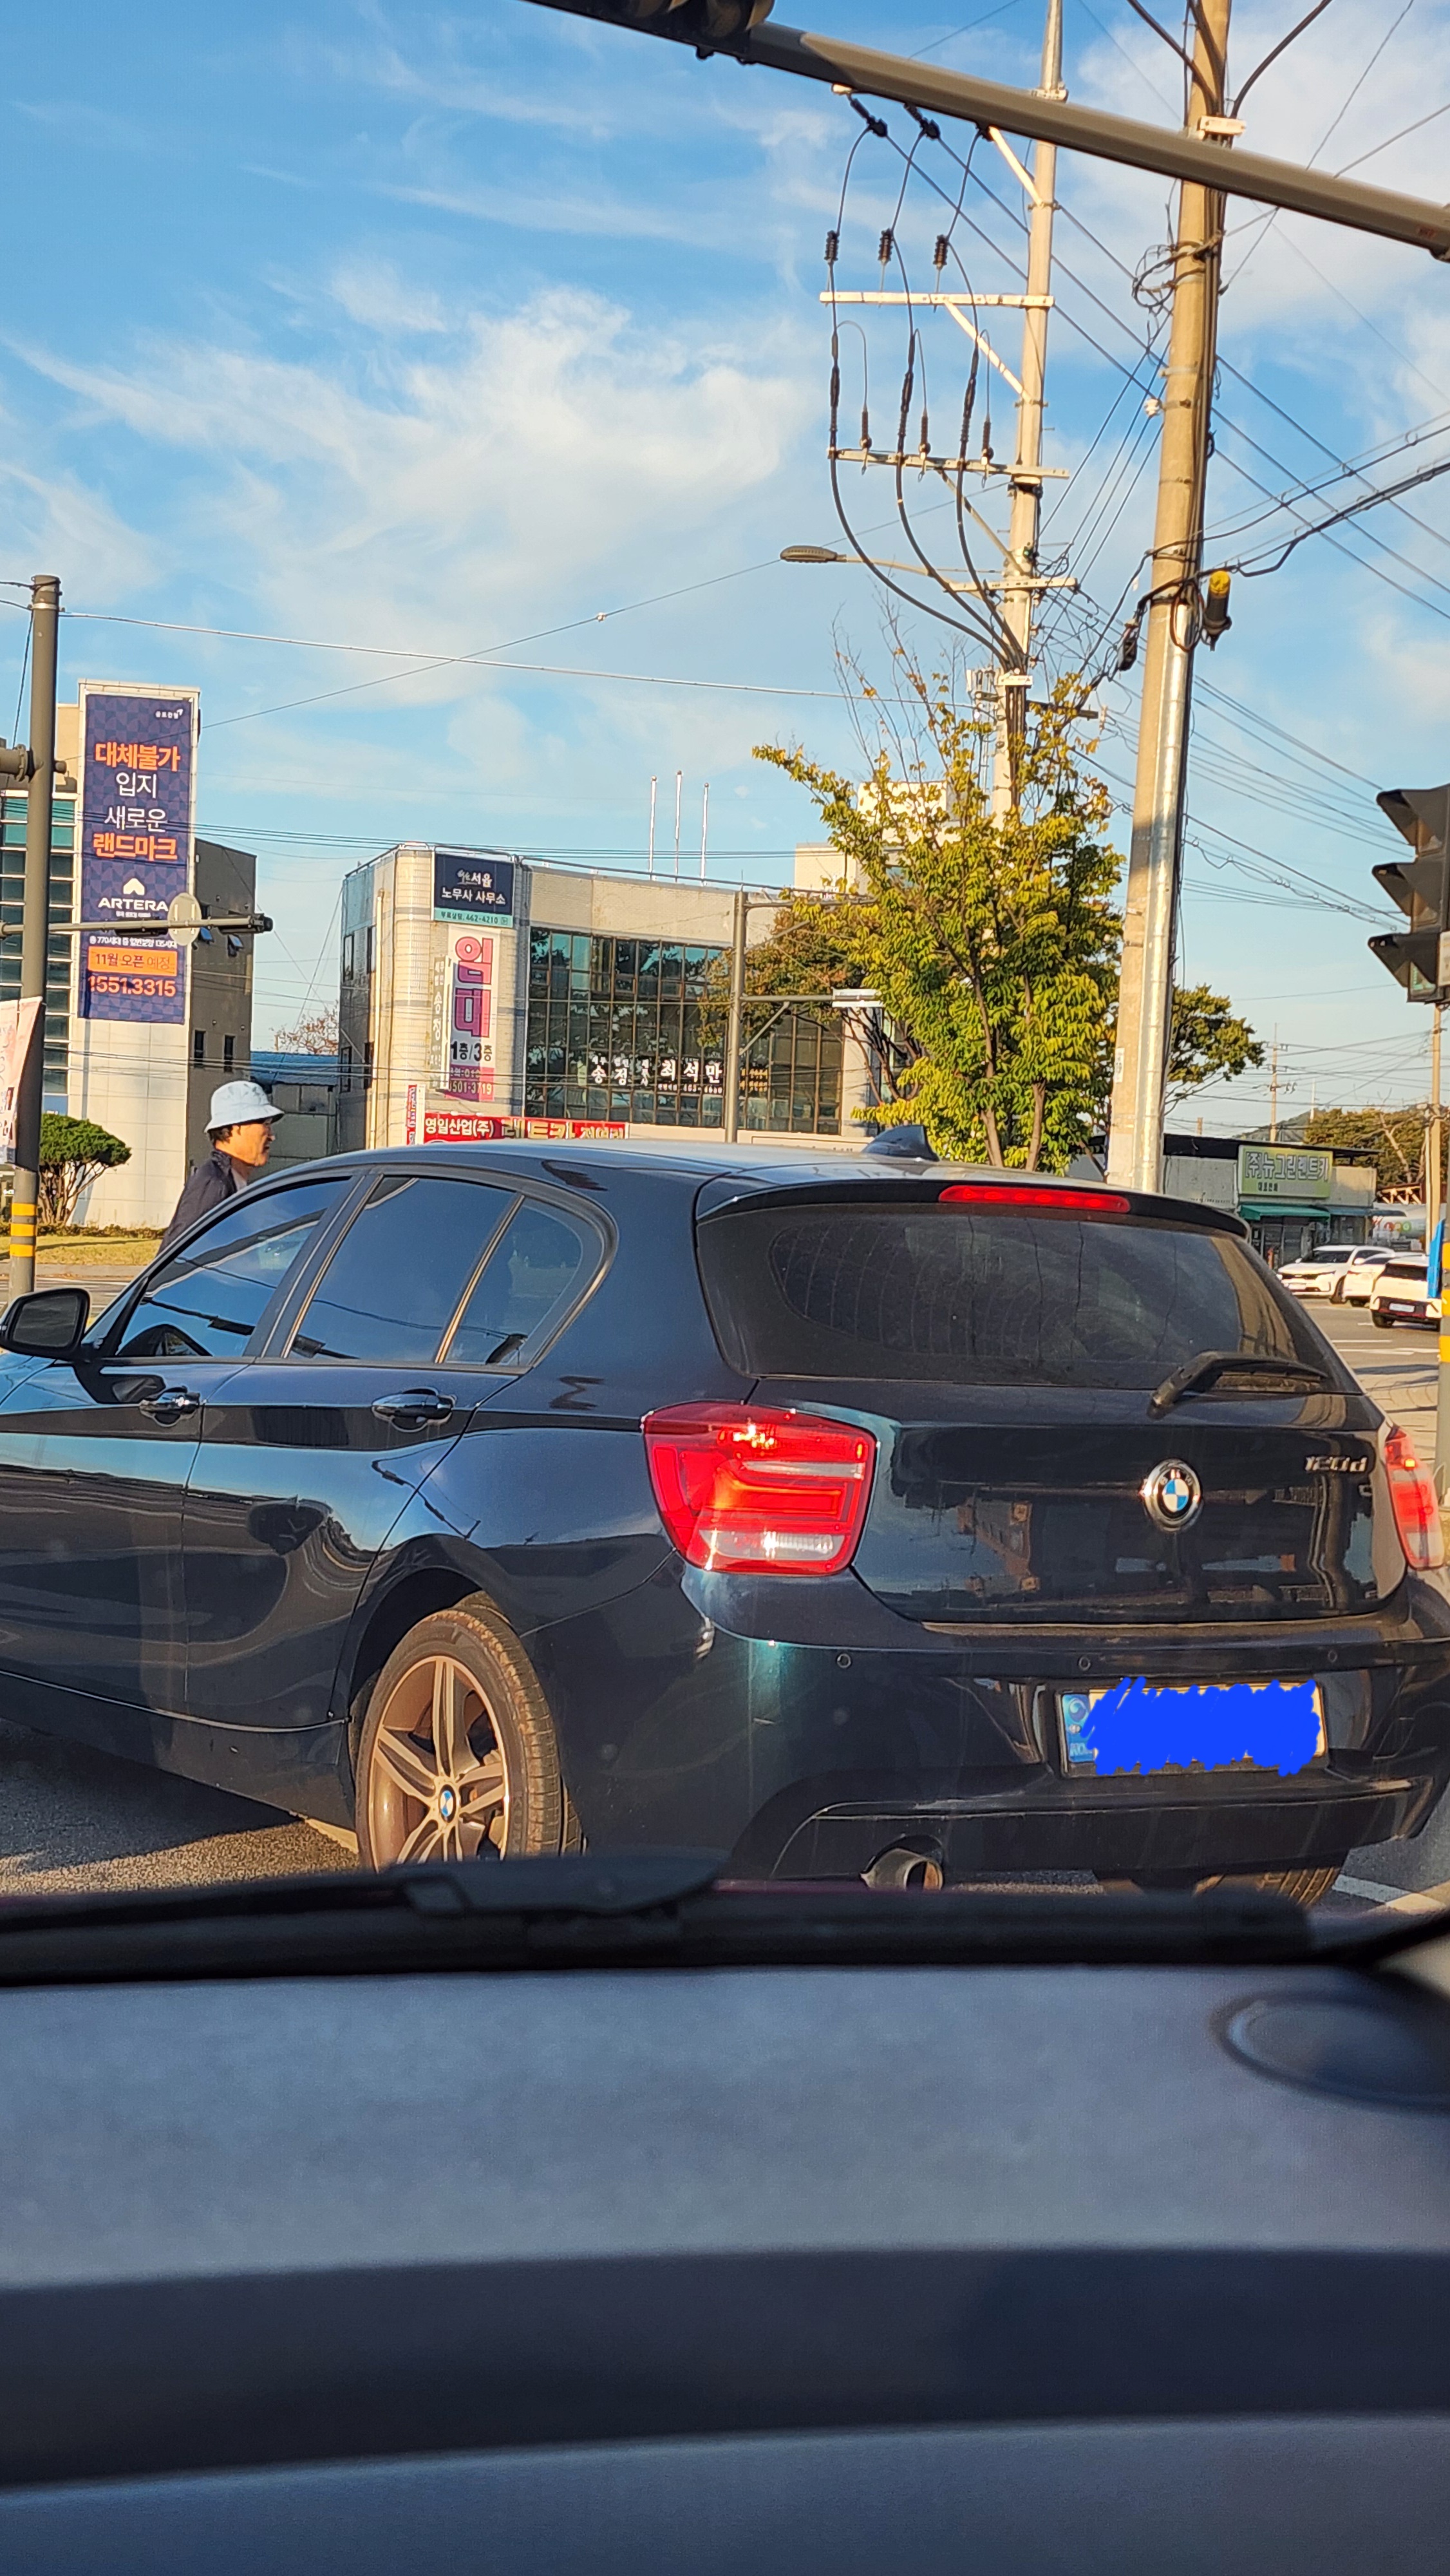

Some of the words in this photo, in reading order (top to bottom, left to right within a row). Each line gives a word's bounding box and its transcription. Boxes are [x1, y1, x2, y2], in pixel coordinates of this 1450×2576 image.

[95, 741, 181, 772] 대체불가
[115, 773, 157, 799] 입지
[104, 806, 167, 833] 새로운
[93, 833, 178, 861] 랜드마크
[98, 897, 169, 912] ARTERA
[442, 887, 473, 902] 노무사
[475, 891, 506, 905] 사무소
[466, 914, 498, 924] 462-4210
[95, 953, 118, 967] 11월
[120, 954, 144, 969] 오픈
[147, 956, 170, 971] 예정
[454, 936, 494, 1039] 임대
[425, 1117, 494, 1138] 영일산업(주)
